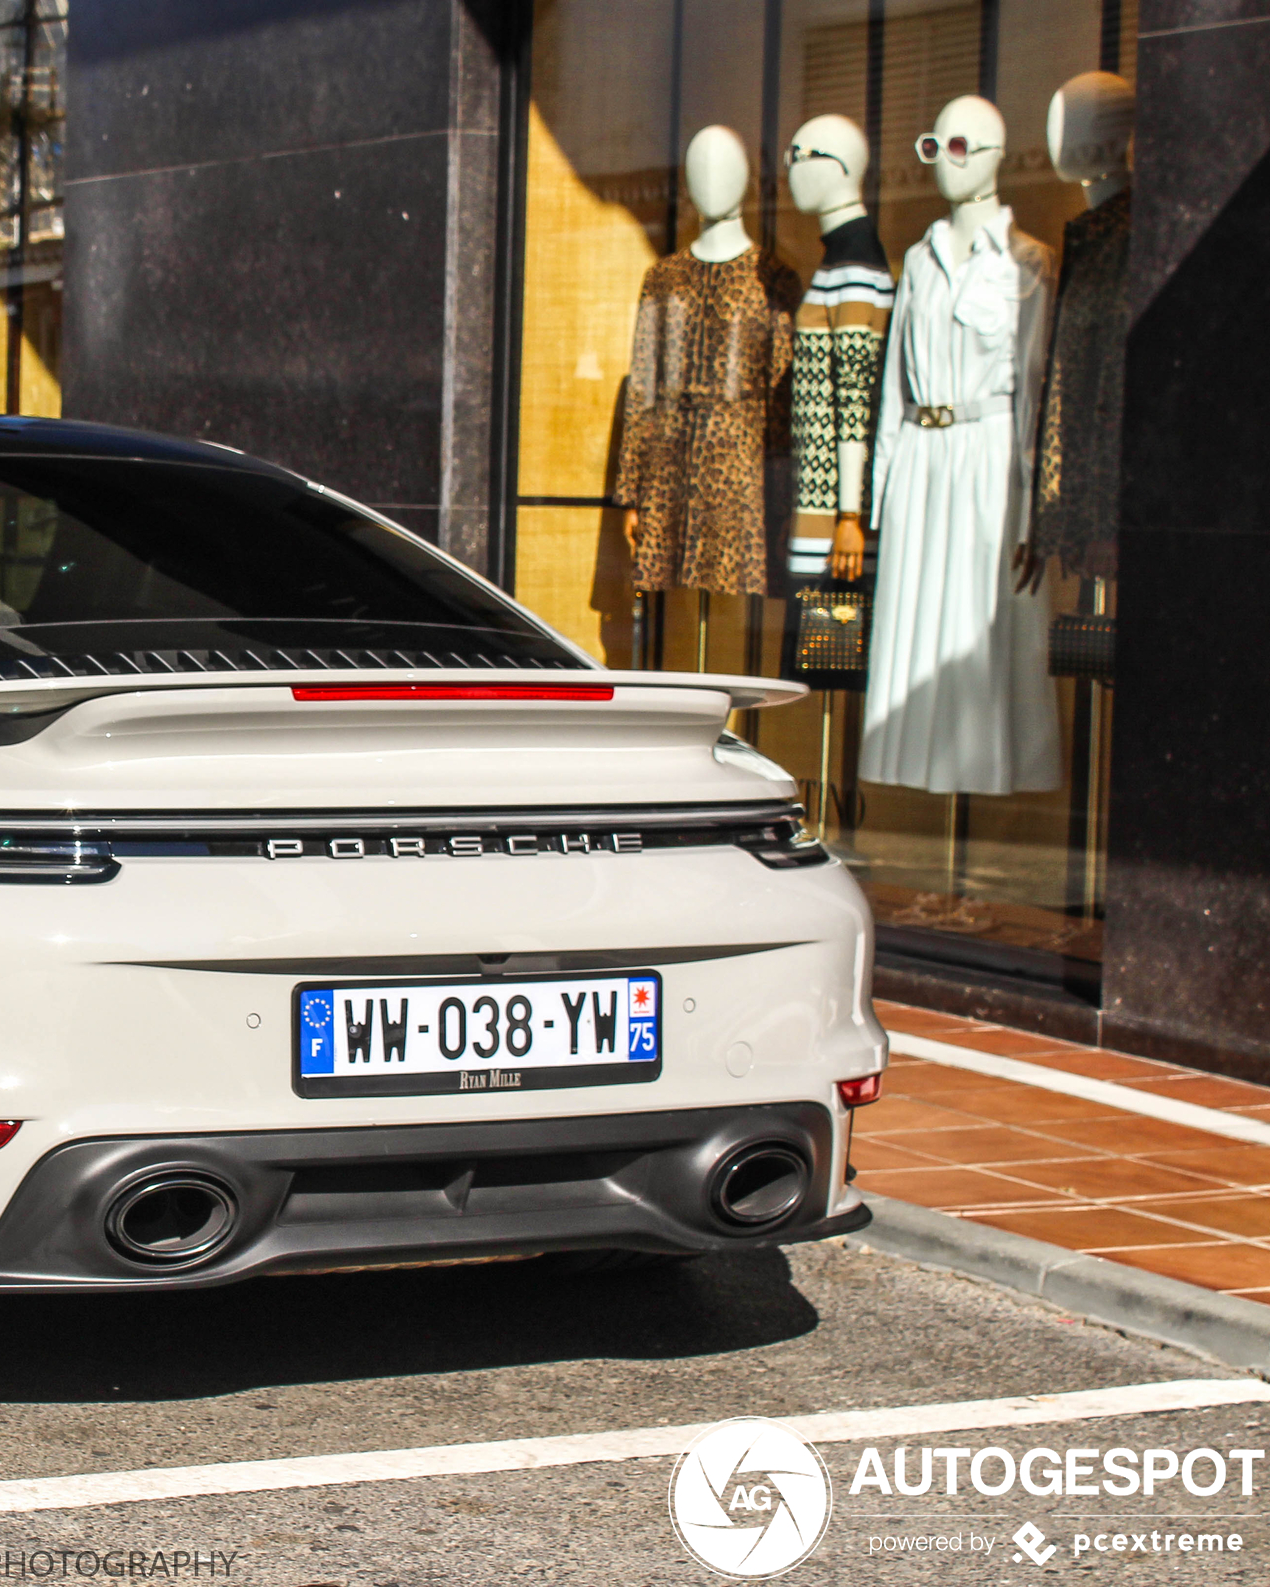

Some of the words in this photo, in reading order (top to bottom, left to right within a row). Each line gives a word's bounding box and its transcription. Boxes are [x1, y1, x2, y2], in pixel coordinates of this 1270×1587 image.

[267, 833, 643, 859] PORSCHE
[344, 990, 618, 1064] WW-038-YW
[630, 1022, 655, 1052] 75
[311, 1038, 324, 1058] F
